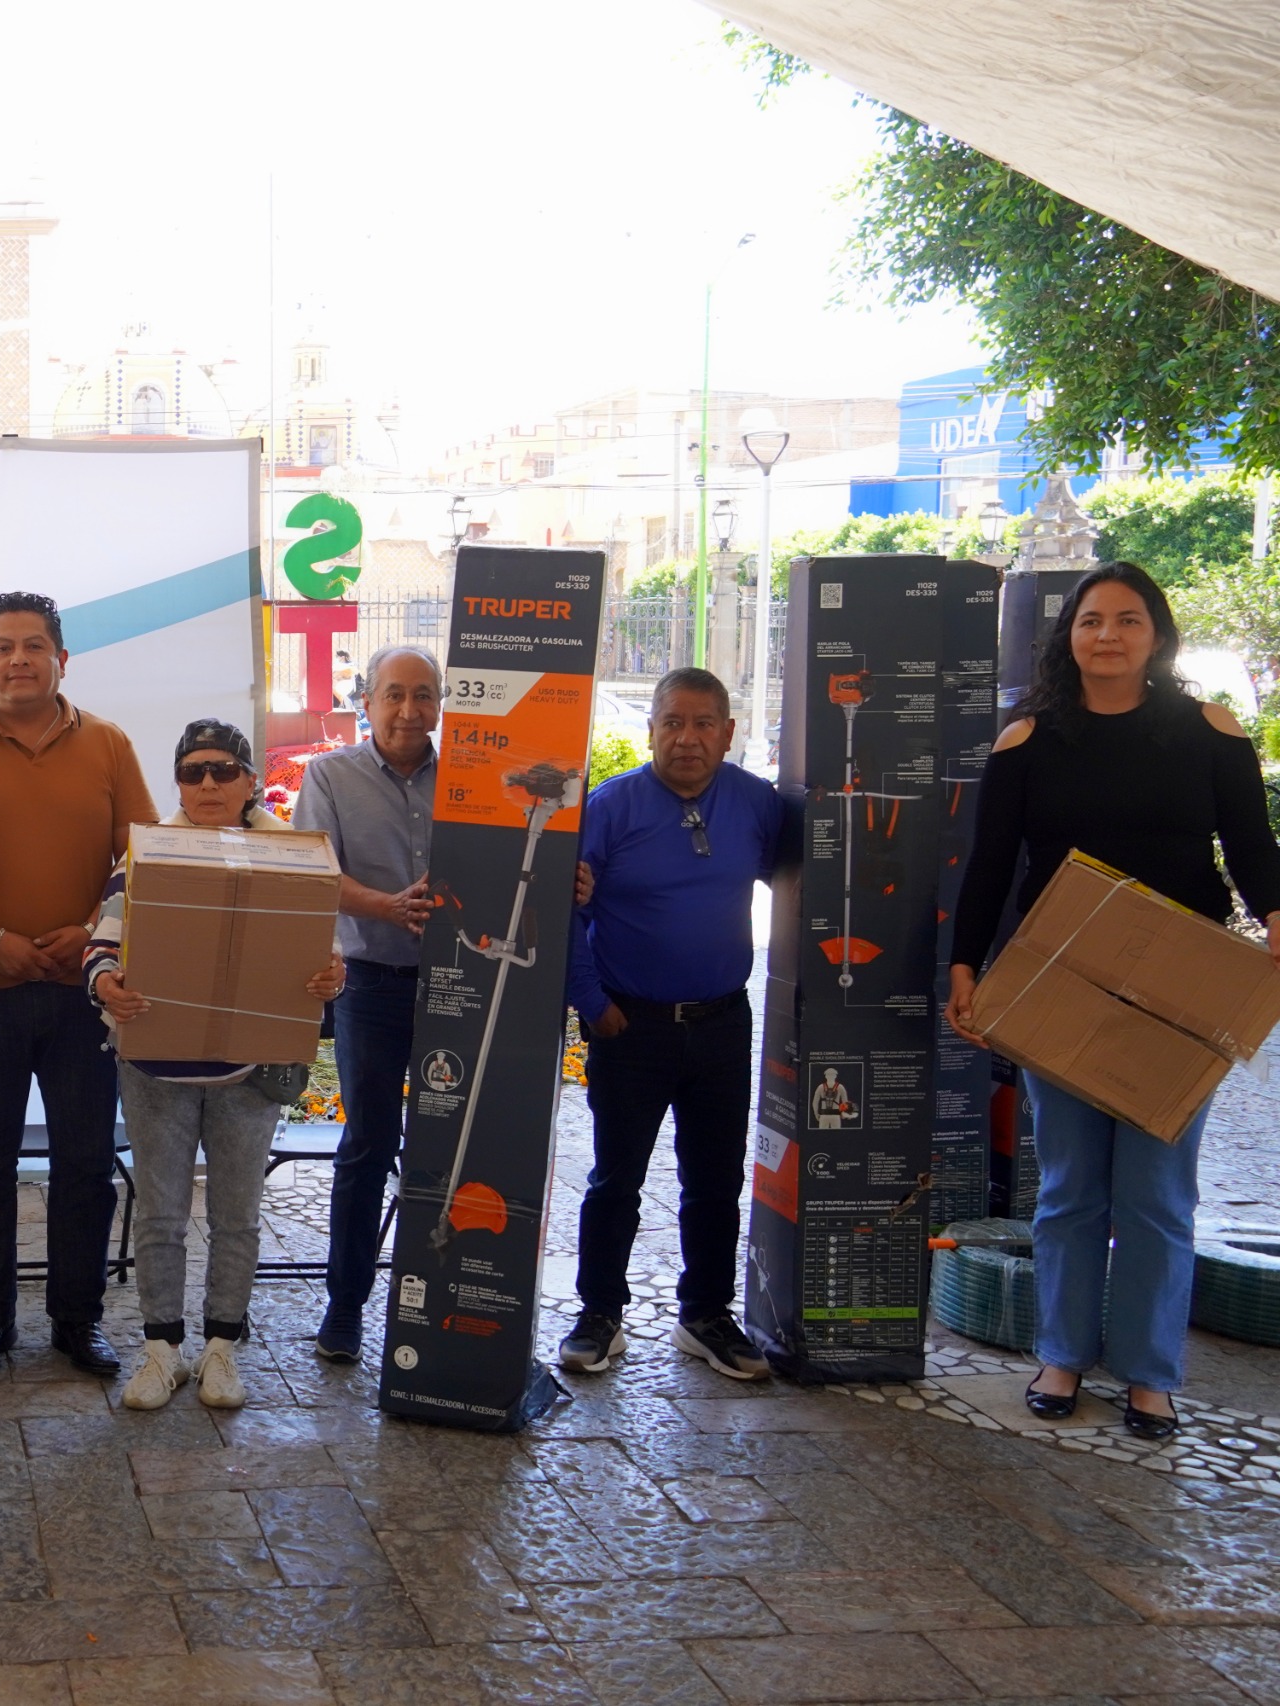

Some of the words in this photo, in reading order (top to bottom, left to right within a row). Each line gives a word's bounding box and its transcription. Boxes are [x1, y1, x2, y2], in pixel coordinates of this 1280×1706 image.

[555, 581, 590, 590] DES-330
[905, 589, 937, 597] DES-330
[463, 596, 572, 620] TRUPER
[460, 633, 531, 644] DESMALEZADORA
[541, 637, 584, 647] GASOLINA
[460, 641, 475, 649] GAS
[477, 642, 534, 652] BRUSHCUTTER
[456, 680, 485, 698] 33
[557, 689, 579, 697] RUDO
[529, 695, 555, 703] HEAVY
[452, 728, 479, 745] 1.4
[483, 731, 509, 750] Hp
[431, 966, 464, 974] MANUBRIO
[453, 985, 475, 993] DESIGN
[427, 1008, 463, 1017] EXTENSIONES
[435, 1004, 461, 1012] GRANDES
[758, 1134, 770, 1154] 33
[403, 1352, 409, 1362] 1
[410, 1393, 414, 1401] 1
[415, 1394, 465, 1411] DESMALEZADORA
[465, 1403, 470, 1411] Y
[470, 1405, 507, 1418] ACCESORIOS
